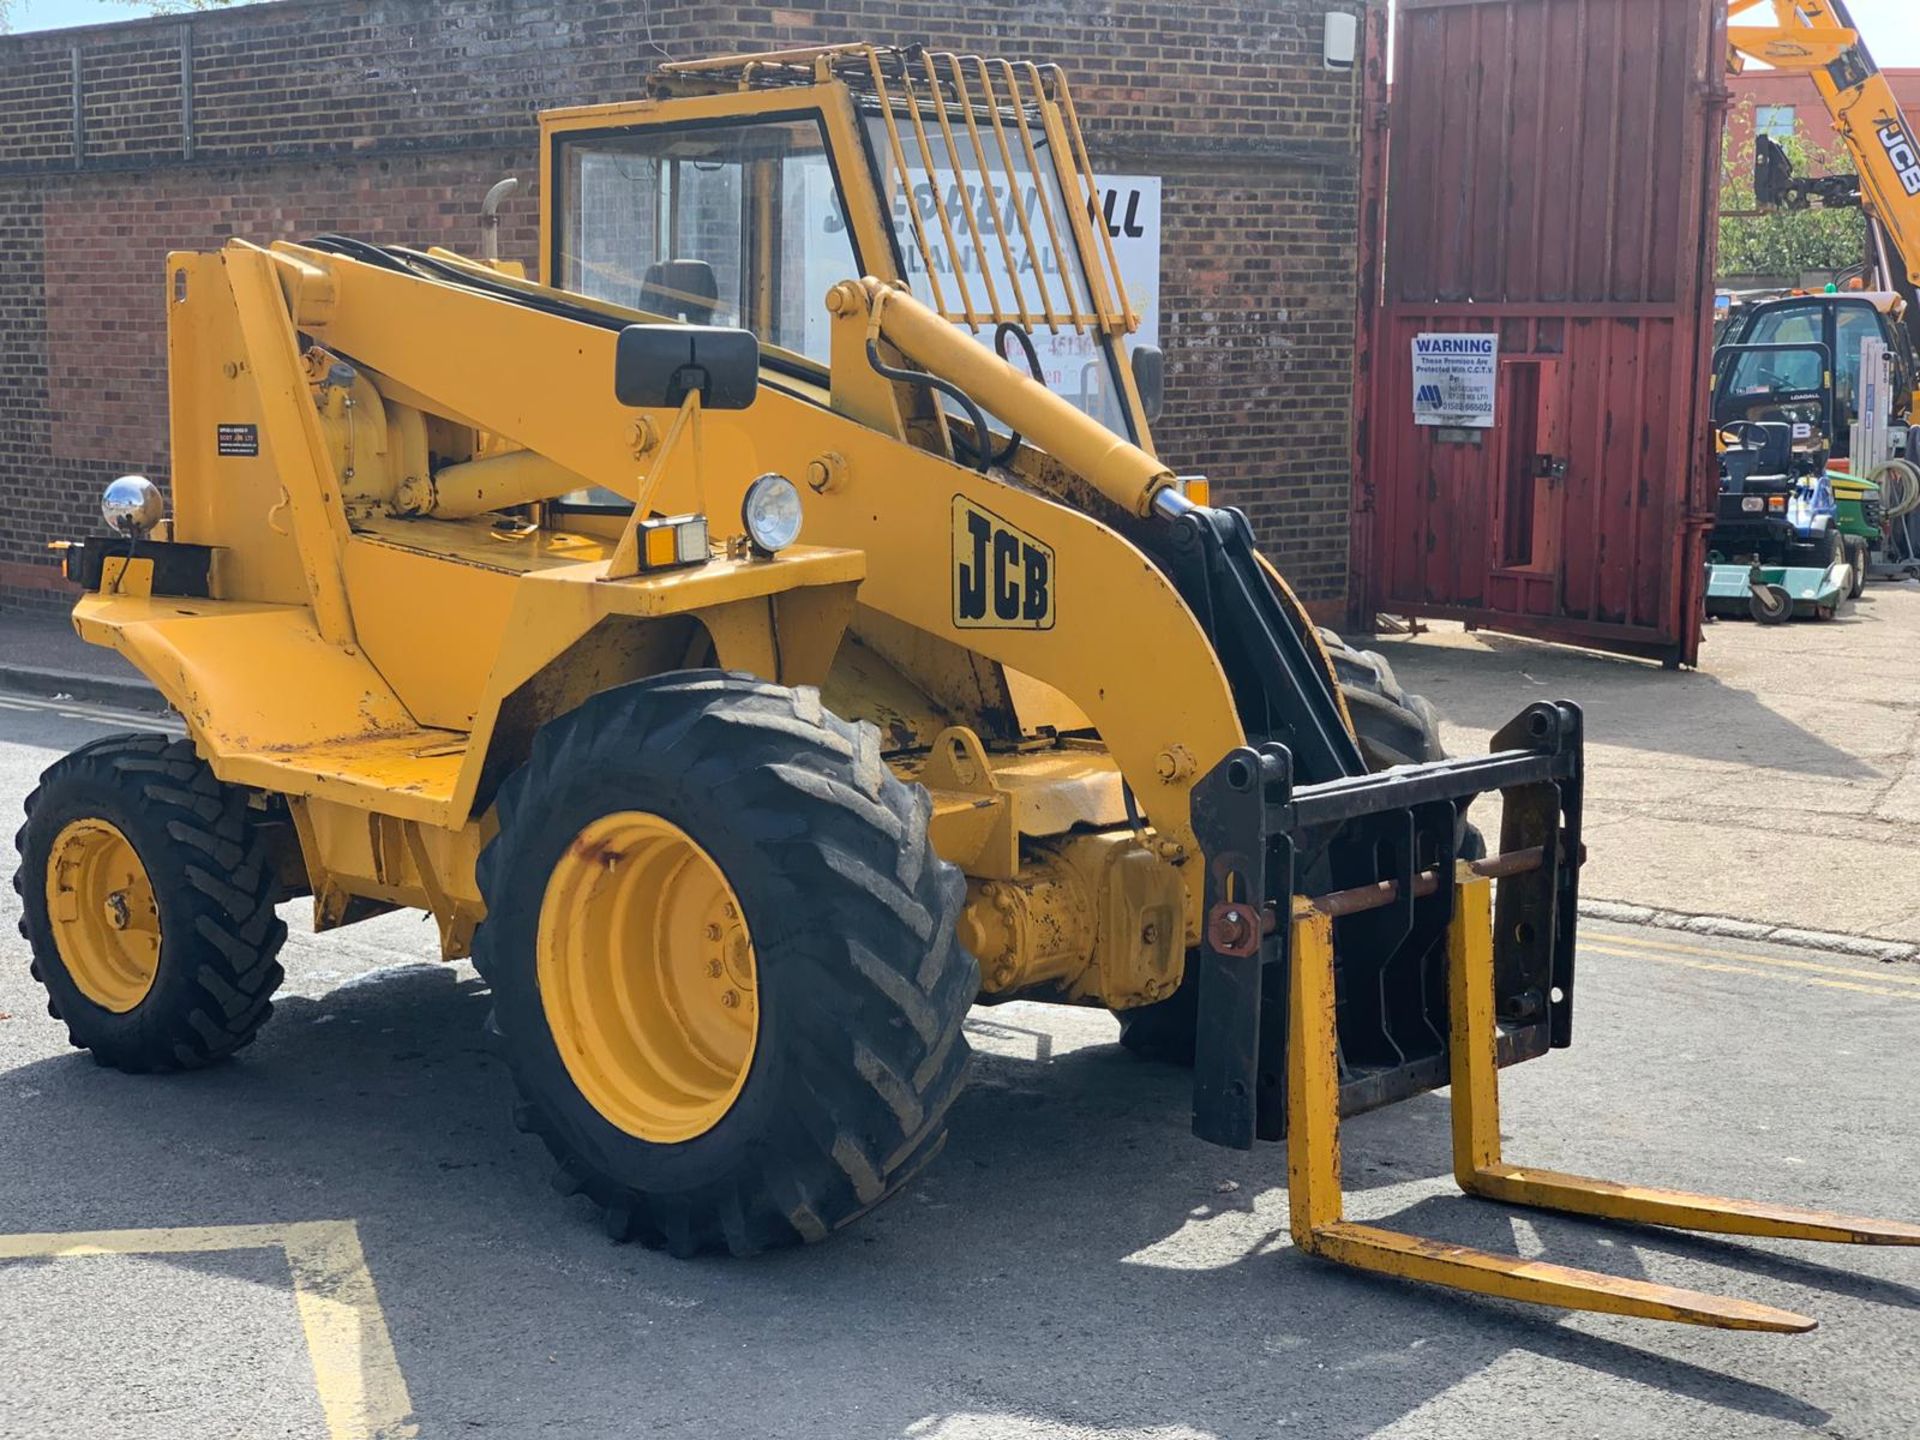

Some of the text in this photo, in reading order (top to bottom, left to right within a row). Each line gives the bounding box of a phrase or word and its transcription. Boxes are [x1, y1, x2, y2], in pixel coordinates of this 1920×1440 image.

[1880, 126, 1920, 195] JCB
[1416, 340, 1492, 353] WARNING
[1416, 366, 1450, 374] Protected
[1790, 393, 1820, 401] LOADALL
[960, 509, 1048, 620] JCB
